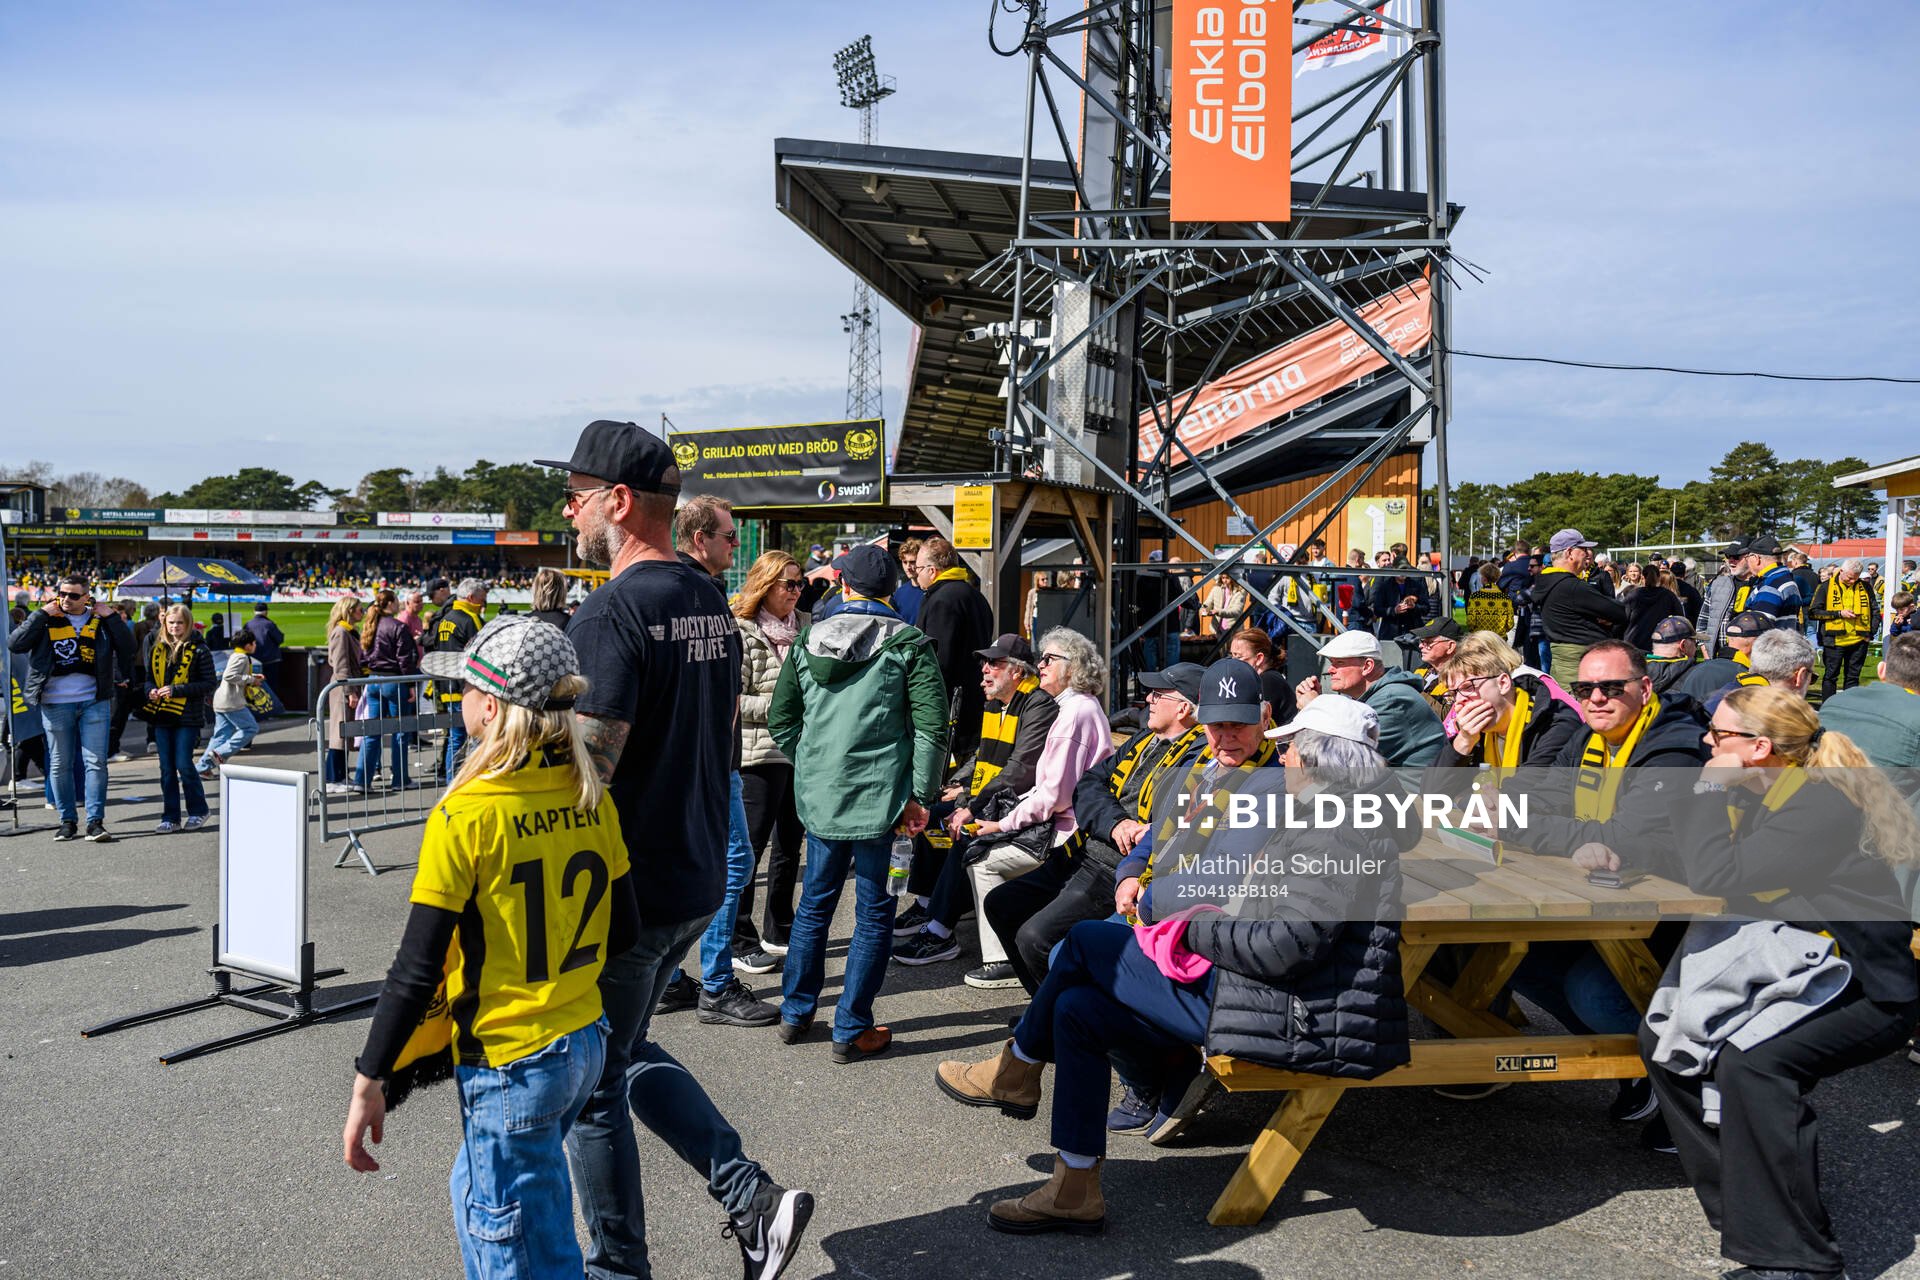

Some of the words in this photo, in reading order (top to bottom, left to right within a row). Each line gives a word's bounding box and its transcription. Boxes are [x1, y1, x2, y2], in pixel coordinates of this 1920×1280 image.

[1189, 7, 1225, 144] Enkla
[1231, 0, 1276, 161] Elbola
[703, 446, 745, 459] GRILLAD
[747, 443, 776, 456] KORV
[778, 441, 804, 455] MED
[806, 438, 838, 453] BRÖD
[1218, 676, 1237, 699] NY
[513, 806, 600, 839] KAPTEN
[511, 850, 609, 984] 12
[1524, 1058, 1554, 1069] JBM
